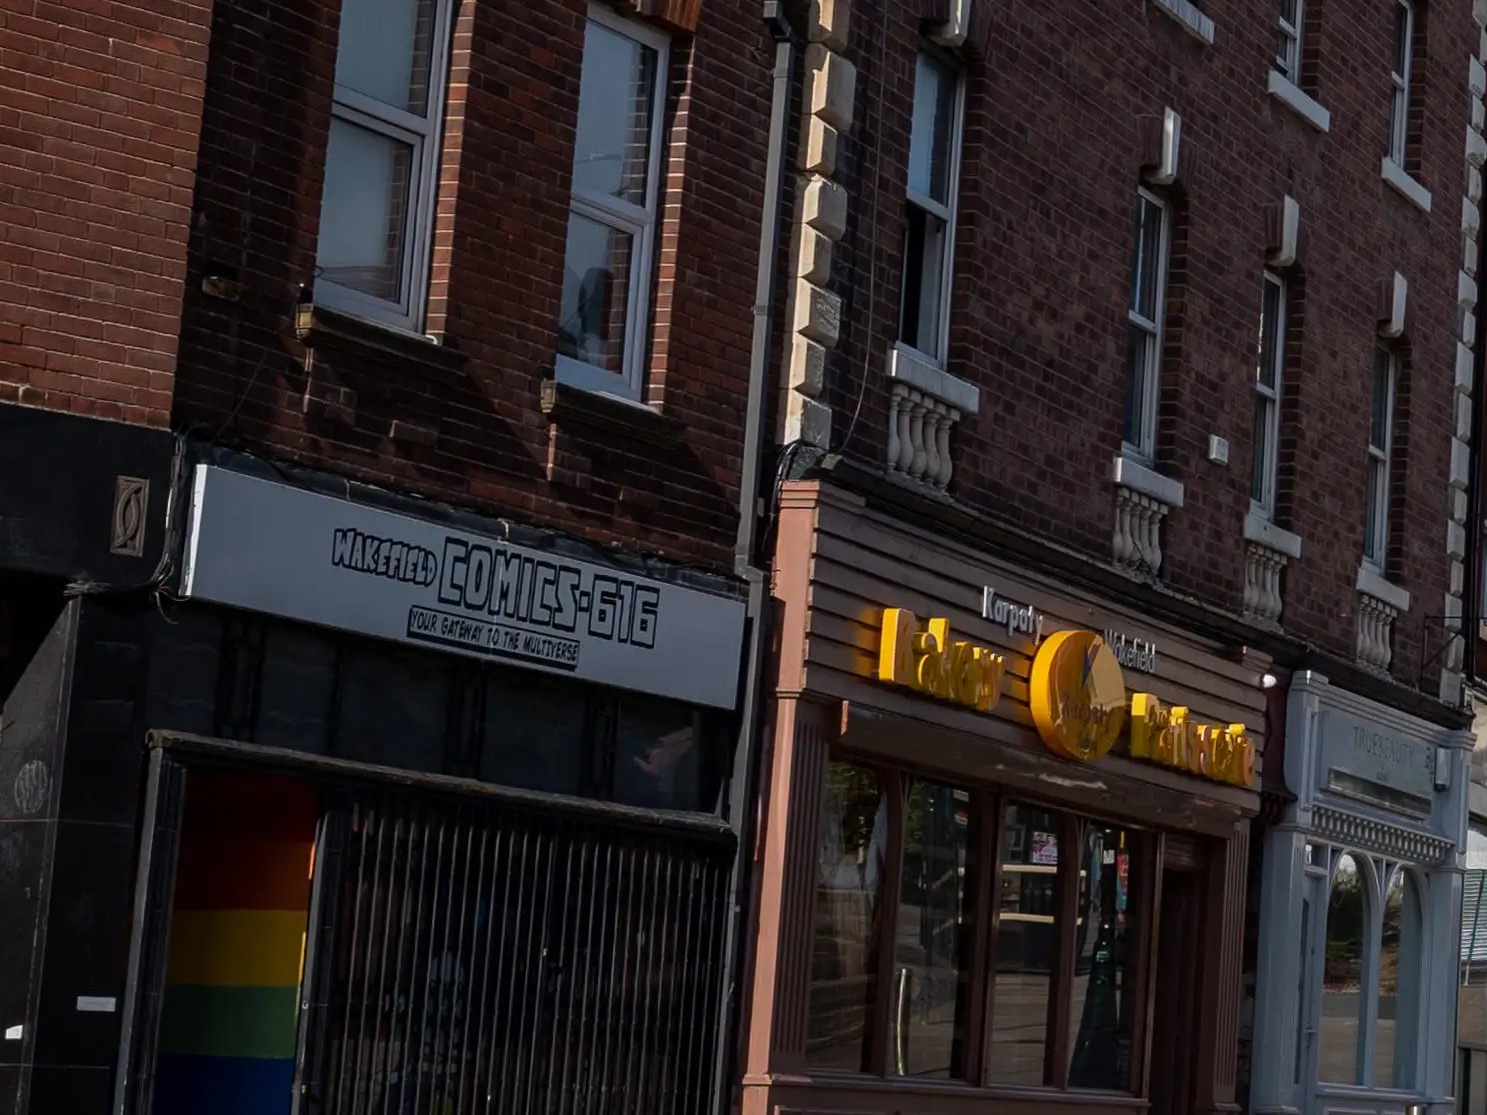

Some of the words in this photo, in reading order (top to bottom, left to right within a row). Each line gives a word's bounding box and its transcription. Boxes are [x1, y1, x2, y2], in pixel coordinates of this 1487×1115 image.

[331, 528, 437, 587] WAKEFIELD
[411, 609, 437, 633] YOUR
[441, 616, 484, 643] GATEWAY
[487, 627, 500, 646] TO
[504, 631, 519, 651] THE
[523, 637, 578, 663] MULTIVERSE
[982, 585, 1043, 645] Karpaty
